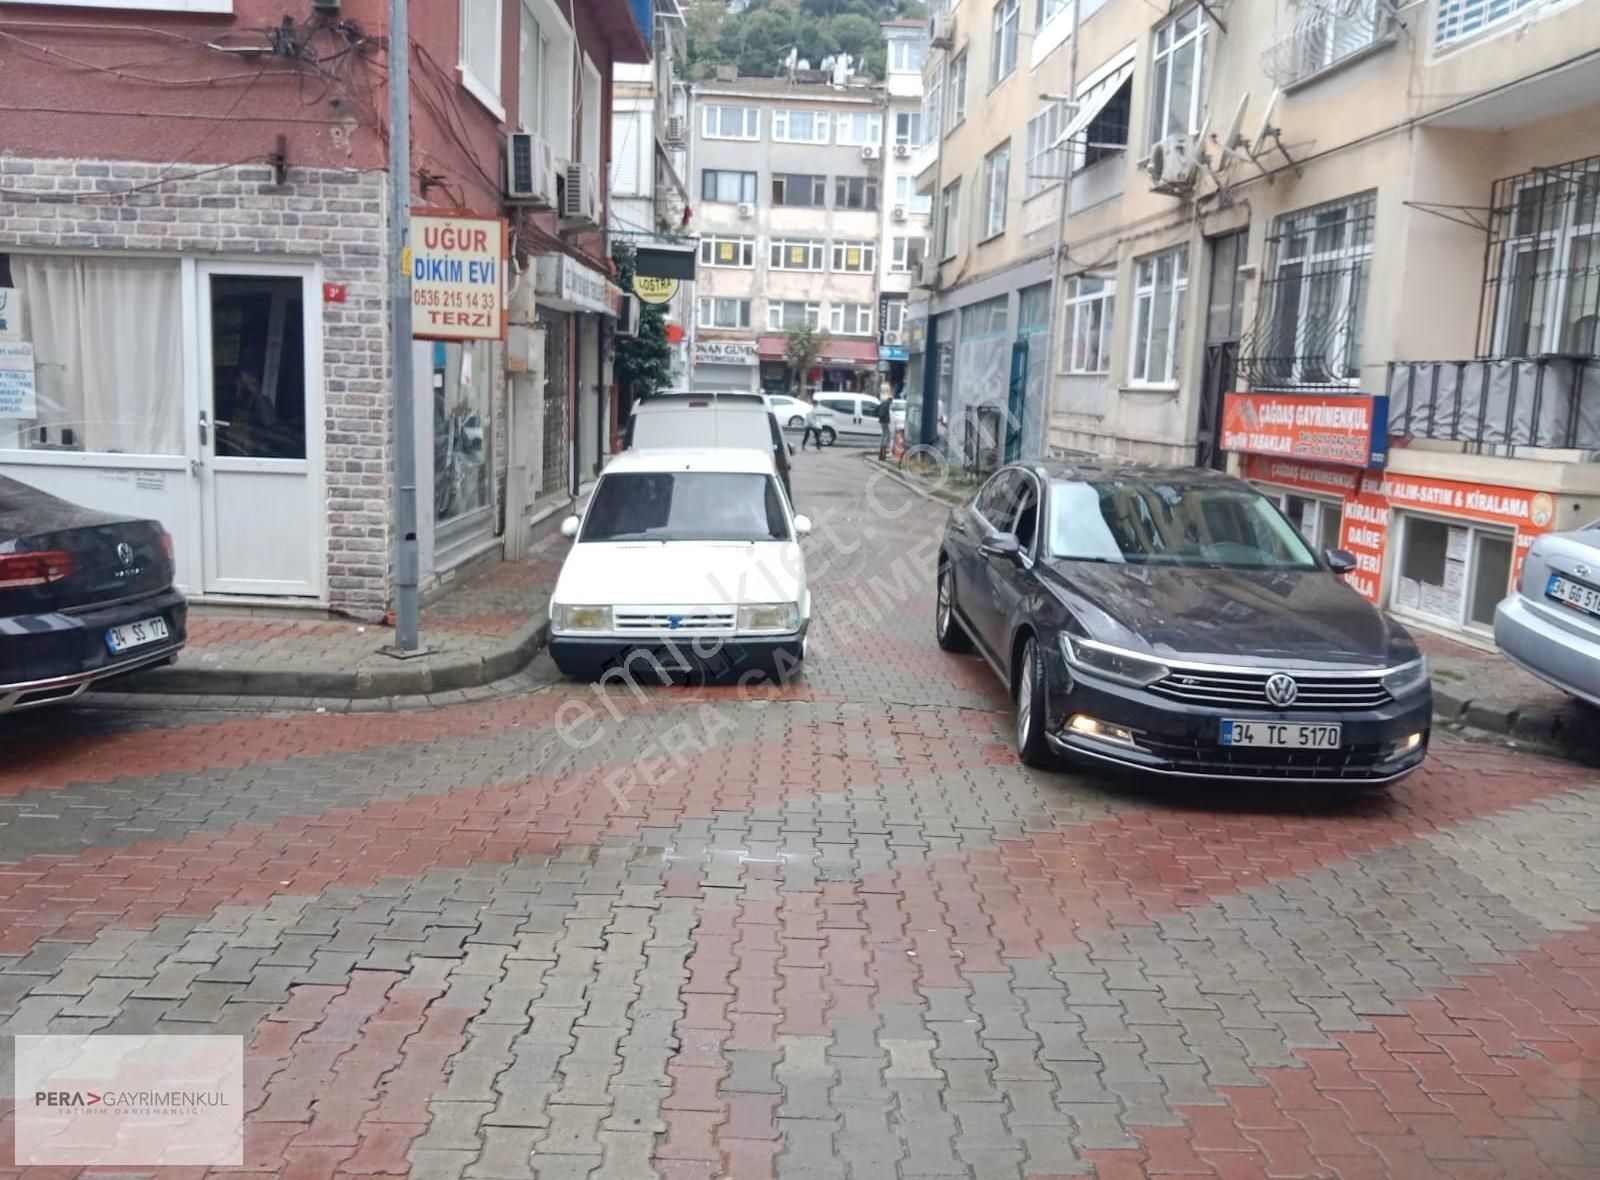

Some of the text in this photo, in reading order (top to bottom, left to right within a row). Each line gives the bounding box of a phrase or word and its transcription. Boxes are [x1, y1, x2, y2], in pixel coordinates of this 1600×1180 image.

[424, 222, 488, 253] UĞUR
[414, 252, 495, 284] DİKİM EVİ
[414, 289, 495, 310] 0536 215 14 33
[427, 310, 493, 328] TERZİ
[1259, 400, 1368, 430] ÇAĞDAŞ GAYRİMENKUL
[1344, 501, 1389, 526] KİRALIK
[1455, 494, 1464, 507] &
[1465, 489, 1529, 517] KİRALAMA
[1347, 526, 1380, 548] DAİRE
[111, 628, 126, 646] 34
[132, 623, 146, 641] SS
[149, 618, 166, 637] 172
[1233, 724, 1254, 744] 34
[1268, 725, 1287, 744] TC
[1299, 726, 1338, 747] 5170
